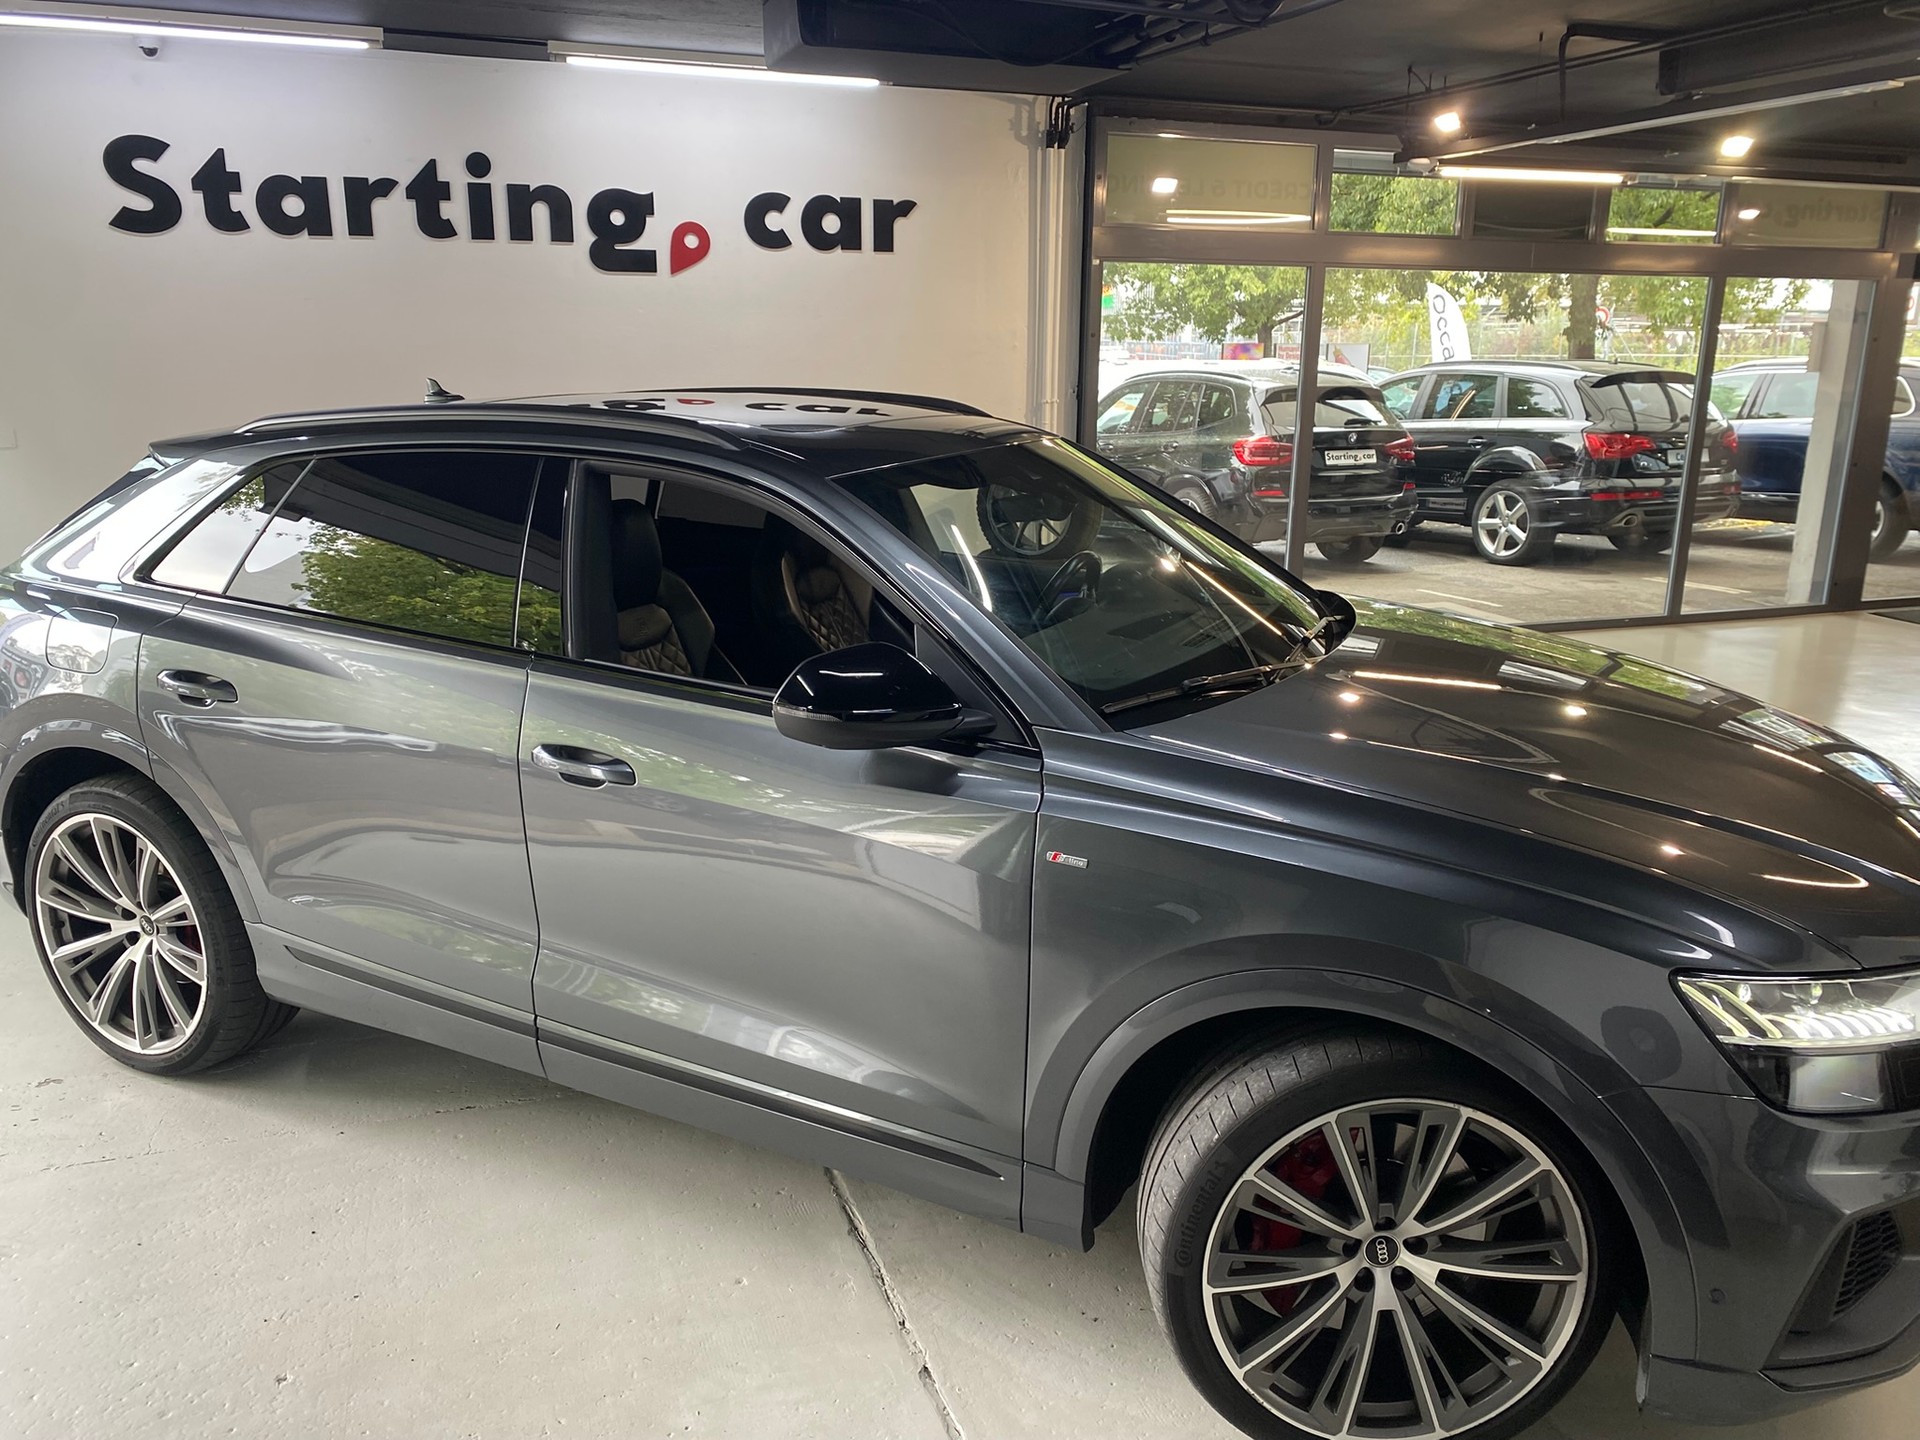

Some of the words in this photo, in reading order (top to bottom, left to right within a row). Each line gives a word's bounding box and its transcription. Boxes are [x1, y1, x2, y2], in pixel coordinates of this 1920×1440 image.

[103, 134, 657, 273] Starting
[744, 191, 918, 253] car
[1326, 452, 1359, 462] Starting
[1174, 1169, 1221, 1267] Continental
